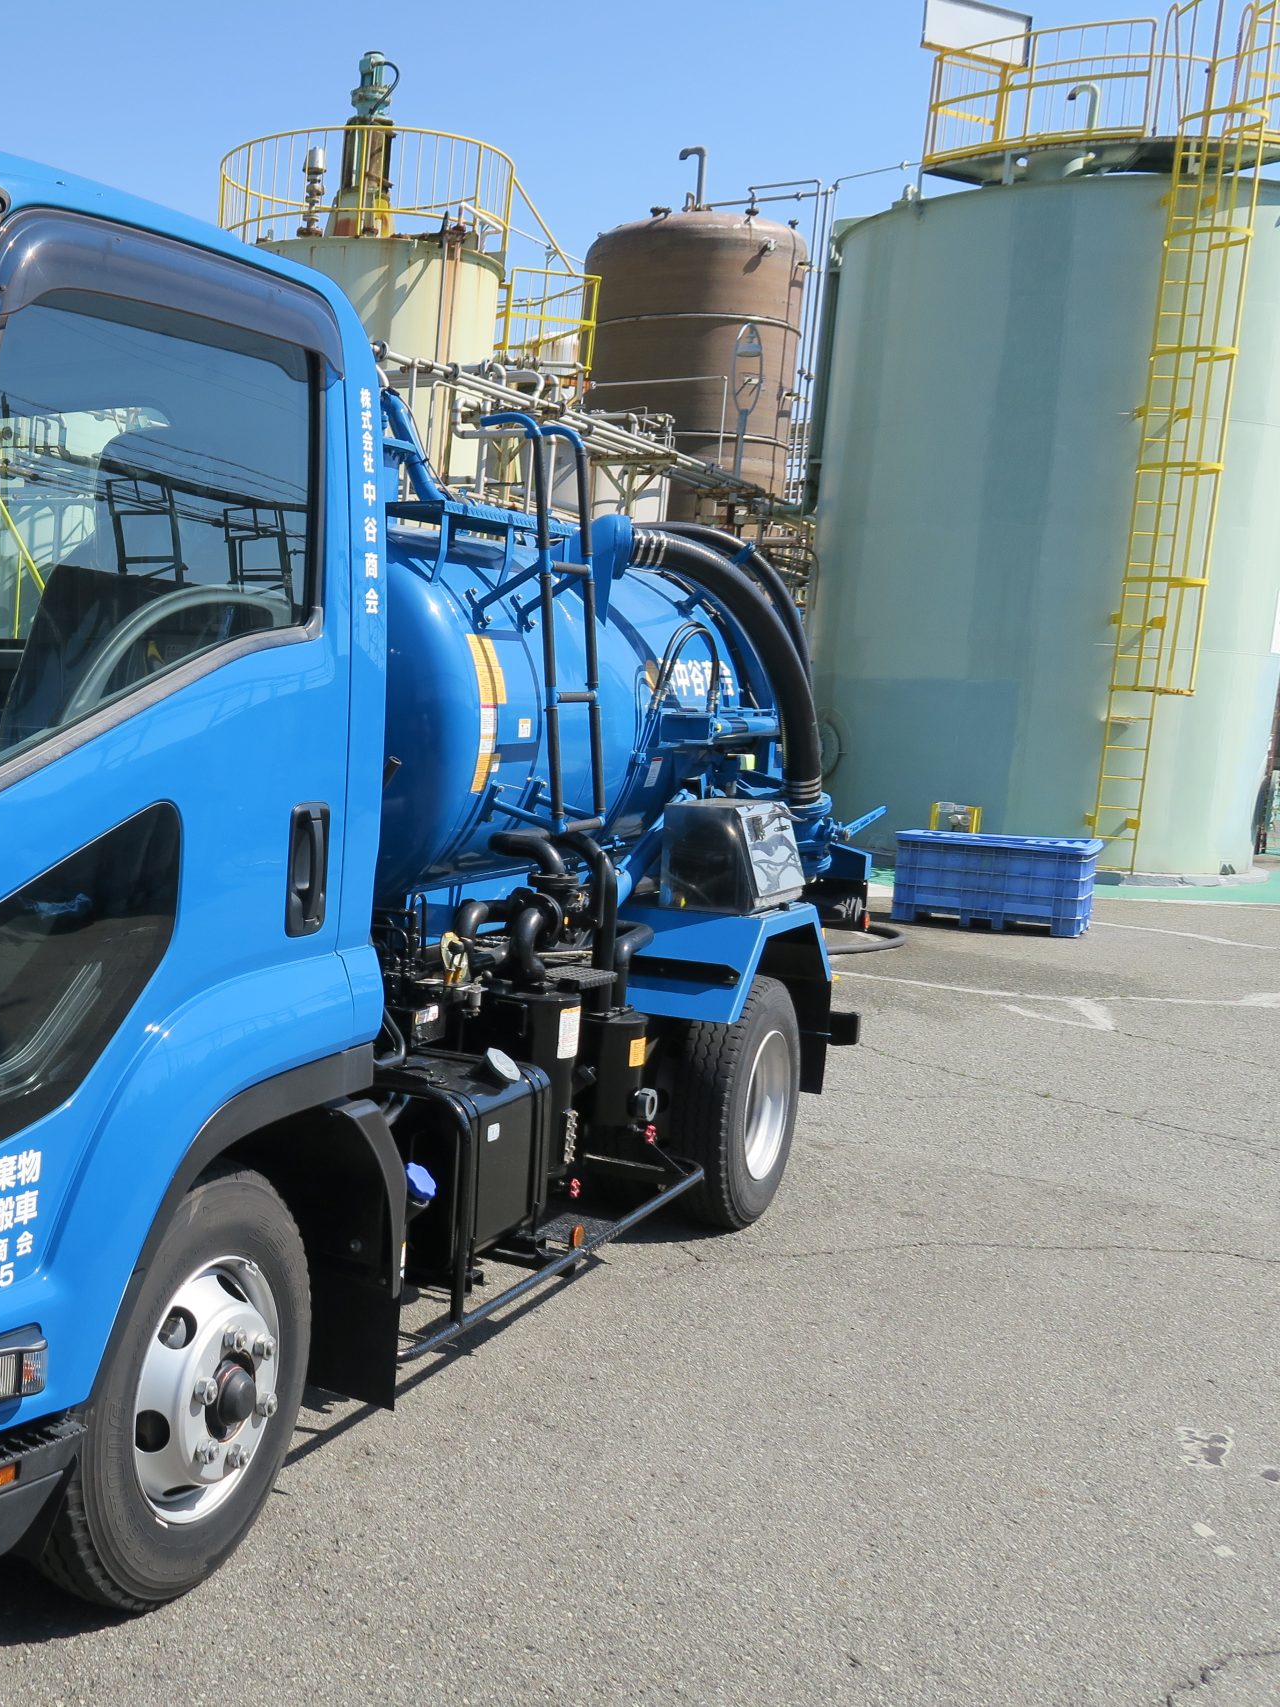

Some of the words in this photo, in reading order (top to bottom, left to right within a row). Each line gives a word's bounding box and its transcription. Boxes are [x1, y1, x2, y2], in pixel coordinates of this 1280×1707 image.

[359, 387, 379, 615] 株式会社中谷商会
